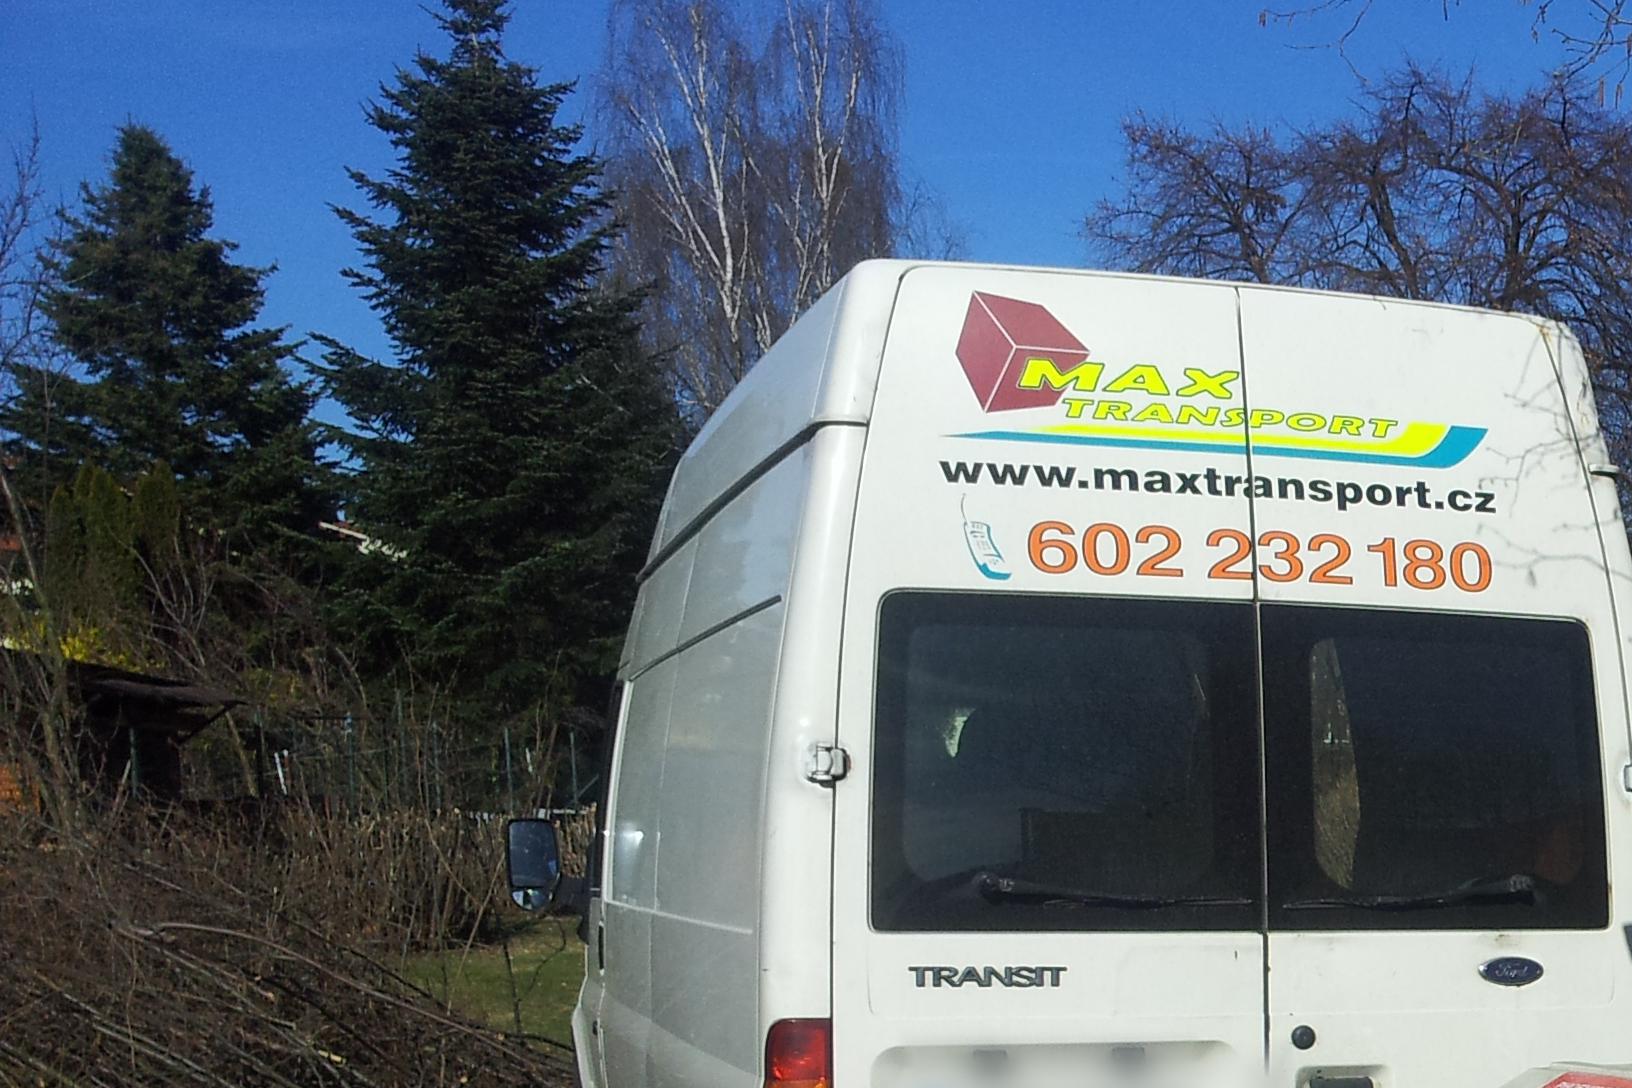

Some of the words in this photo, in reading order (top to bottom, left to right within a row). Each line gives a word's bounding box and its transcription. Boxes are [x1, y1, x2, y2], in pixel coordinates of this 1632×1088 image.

[1018, 357, 1240, 400] MAX
[1062, 397, 1398, 439] TRANSPORT
[939, 459, 1497, 514] www.maxtransport.cz
[1027, 520, 1183, 578] 602
[1207, 528, 1353, 586] 232
[1366, 536, 1493, 592] 180
[908, 965, 1067, 988] TRANSIT
